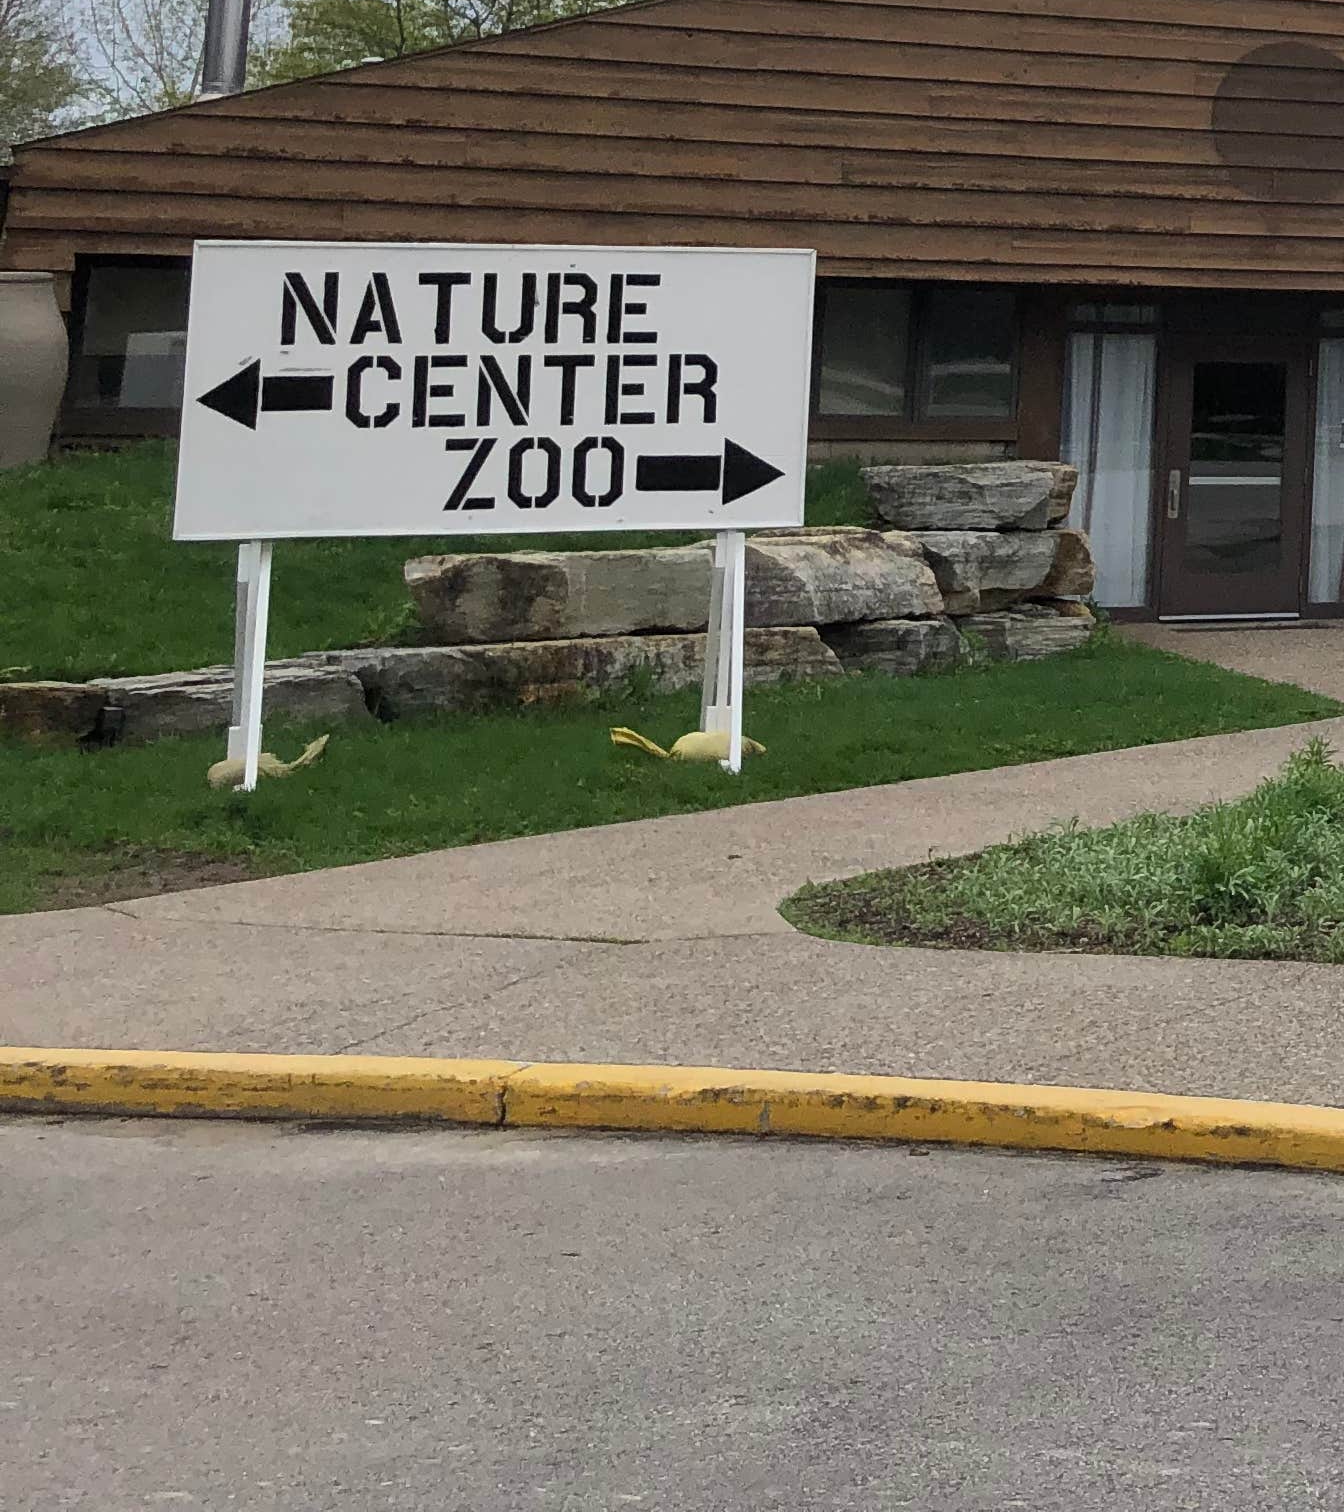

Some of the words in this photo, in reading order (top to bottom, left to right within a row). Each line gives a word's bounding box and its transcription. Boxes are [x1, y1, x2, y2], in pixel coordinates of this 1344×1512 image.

[280, 271, 662, 346] NATURE
[345, 353, 719, 429] CENTER
[442, 435, 626, 512] ZOO
